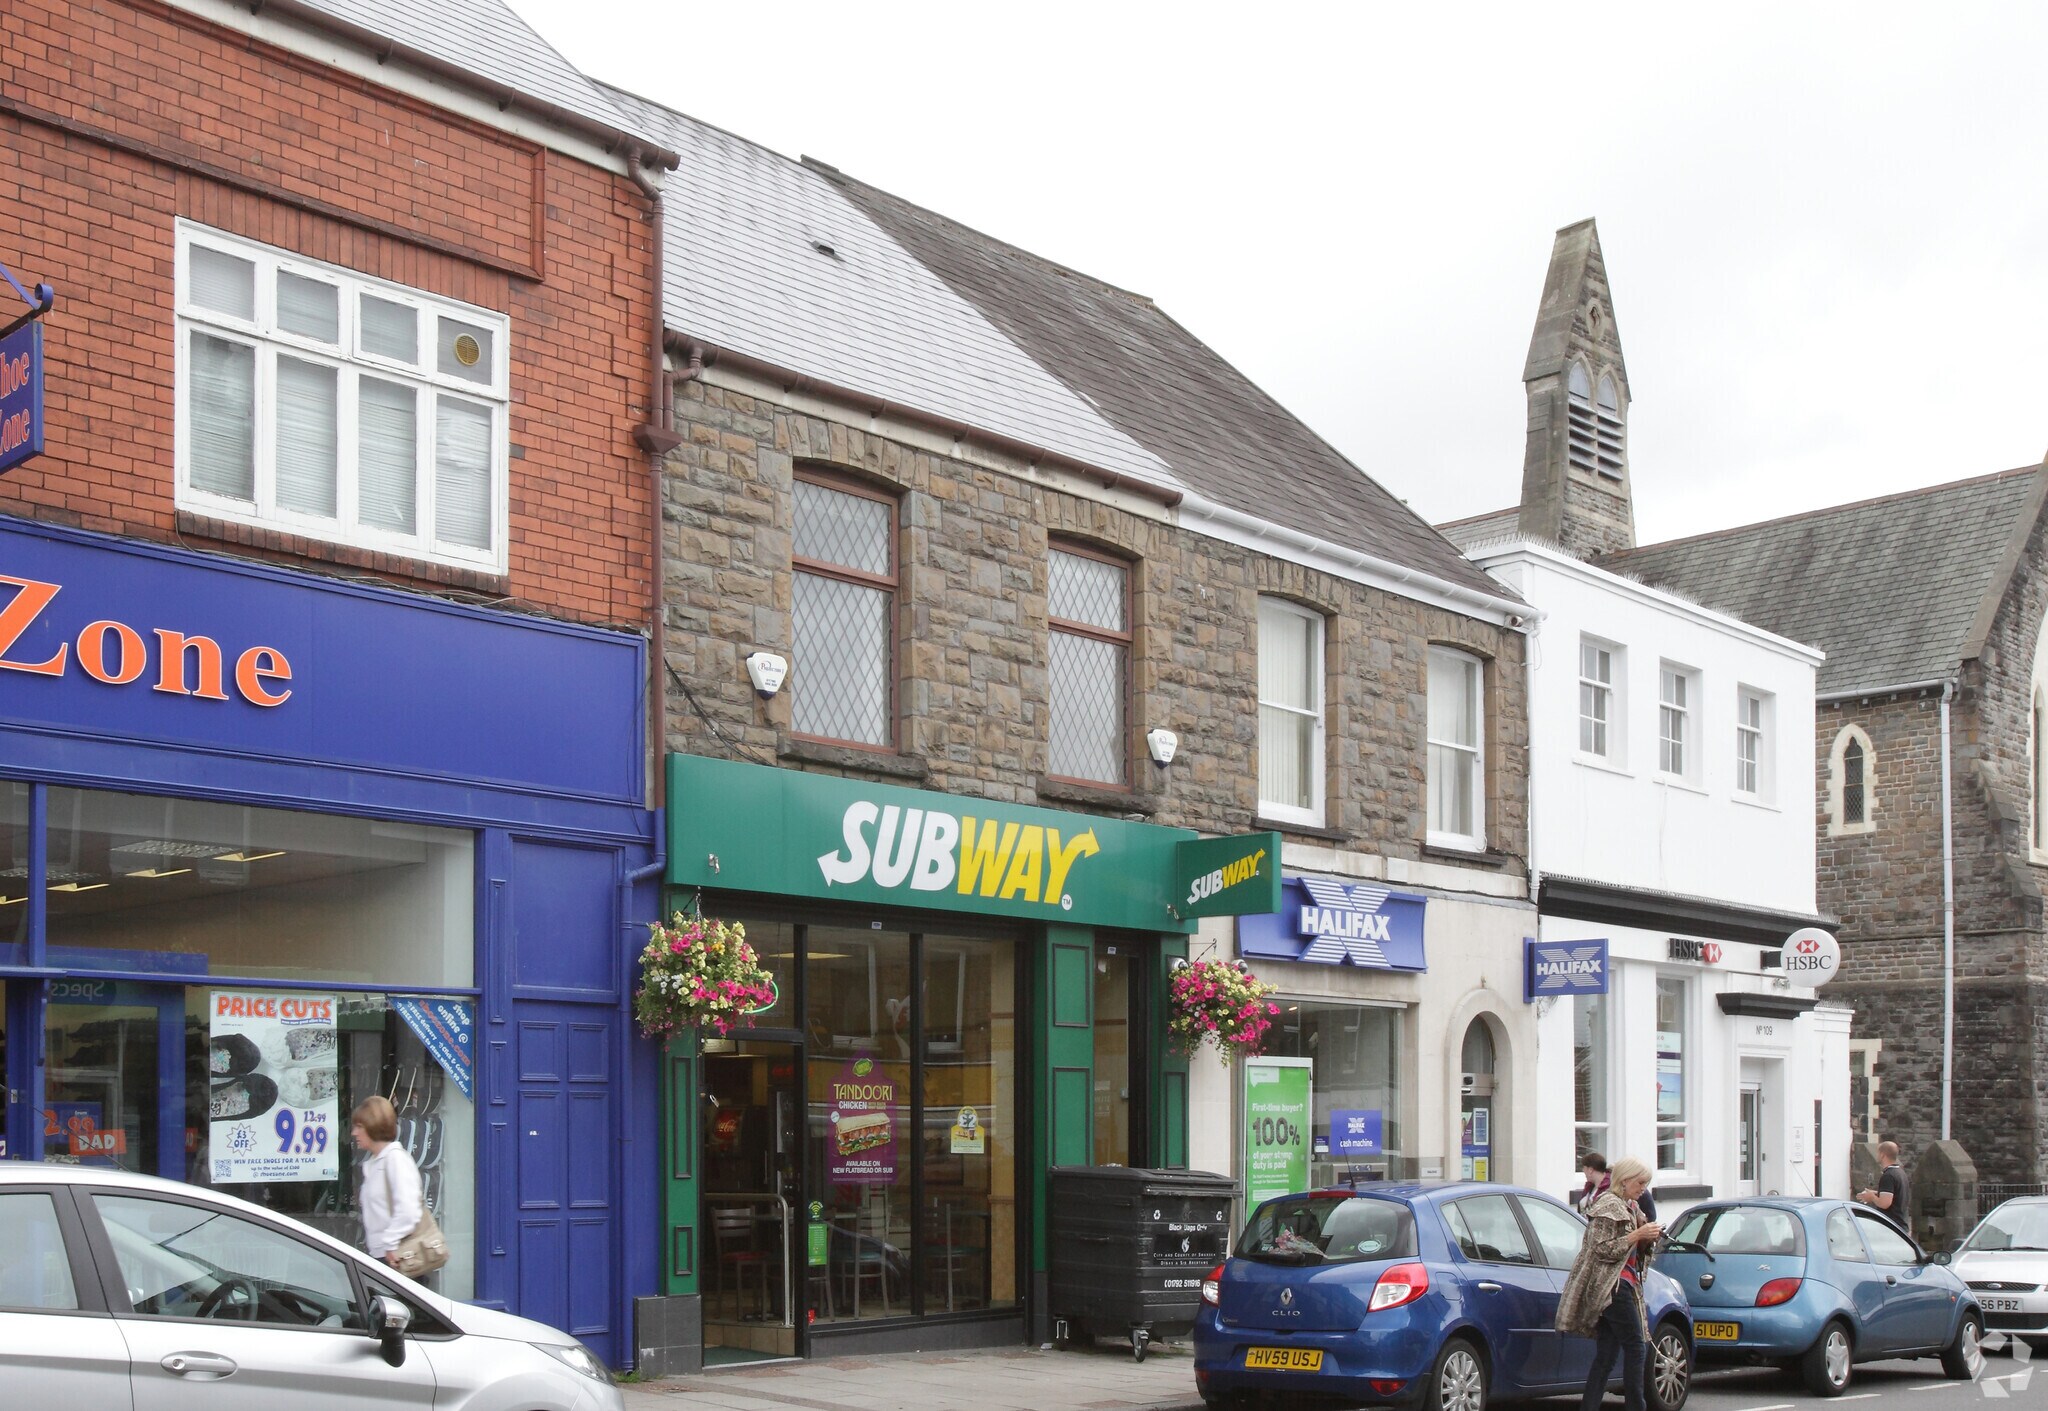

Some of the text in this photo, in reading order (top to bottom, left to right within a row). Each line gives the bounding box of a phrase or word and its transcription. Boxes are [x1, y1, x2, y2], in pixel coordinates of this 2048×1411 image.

[0, 352, 30, 399] hoe
[0, 574, 292, 707] Zone
[817, 800, 1100, 905] SUBWAY
[1186, 848, 1266, 905] SUBWAY
[1301, 906, 1391, 941] HALIFAX
[1668, 938, 1704, 961] HSBC
[1536, 960, 1602, 976] HALIFAX
[1785, 955, 1832, 971] HSBC
[217, 995, 331, 1018] PRICE CUTS
[453, 1003, 470, 1026] shop
[437, 1005, 460, 1034] online
[1763, 1026, 1773, 1036] 109
[833, 1084, 892, 1100] TANDOORI
[839, 1101, 867, 1109] CHICKEN
[1252, 1103, 1303, 1113] First-time buyer?
[303, 1110, 327, 1122] 12.99
[237, 1130, 246, 1139] £3
[274, 1107, 328, 1154] 9.99
[1252, 1117, 1300, 1146] 100%
[78, 1134, 116, 1151] DAD
[234, 1140, 249, 1148] OFF
[1340, 1138, 1373, 1147] cash machine
[1252, 1160, 1287, 1171] duty is paid
[1978, 1300, 2019, 1311] 56 PBZ
[1696, 1324, 1733, 1337] 51 UPO
[1254, 1350, 1321, 1367] HV59 USJ
